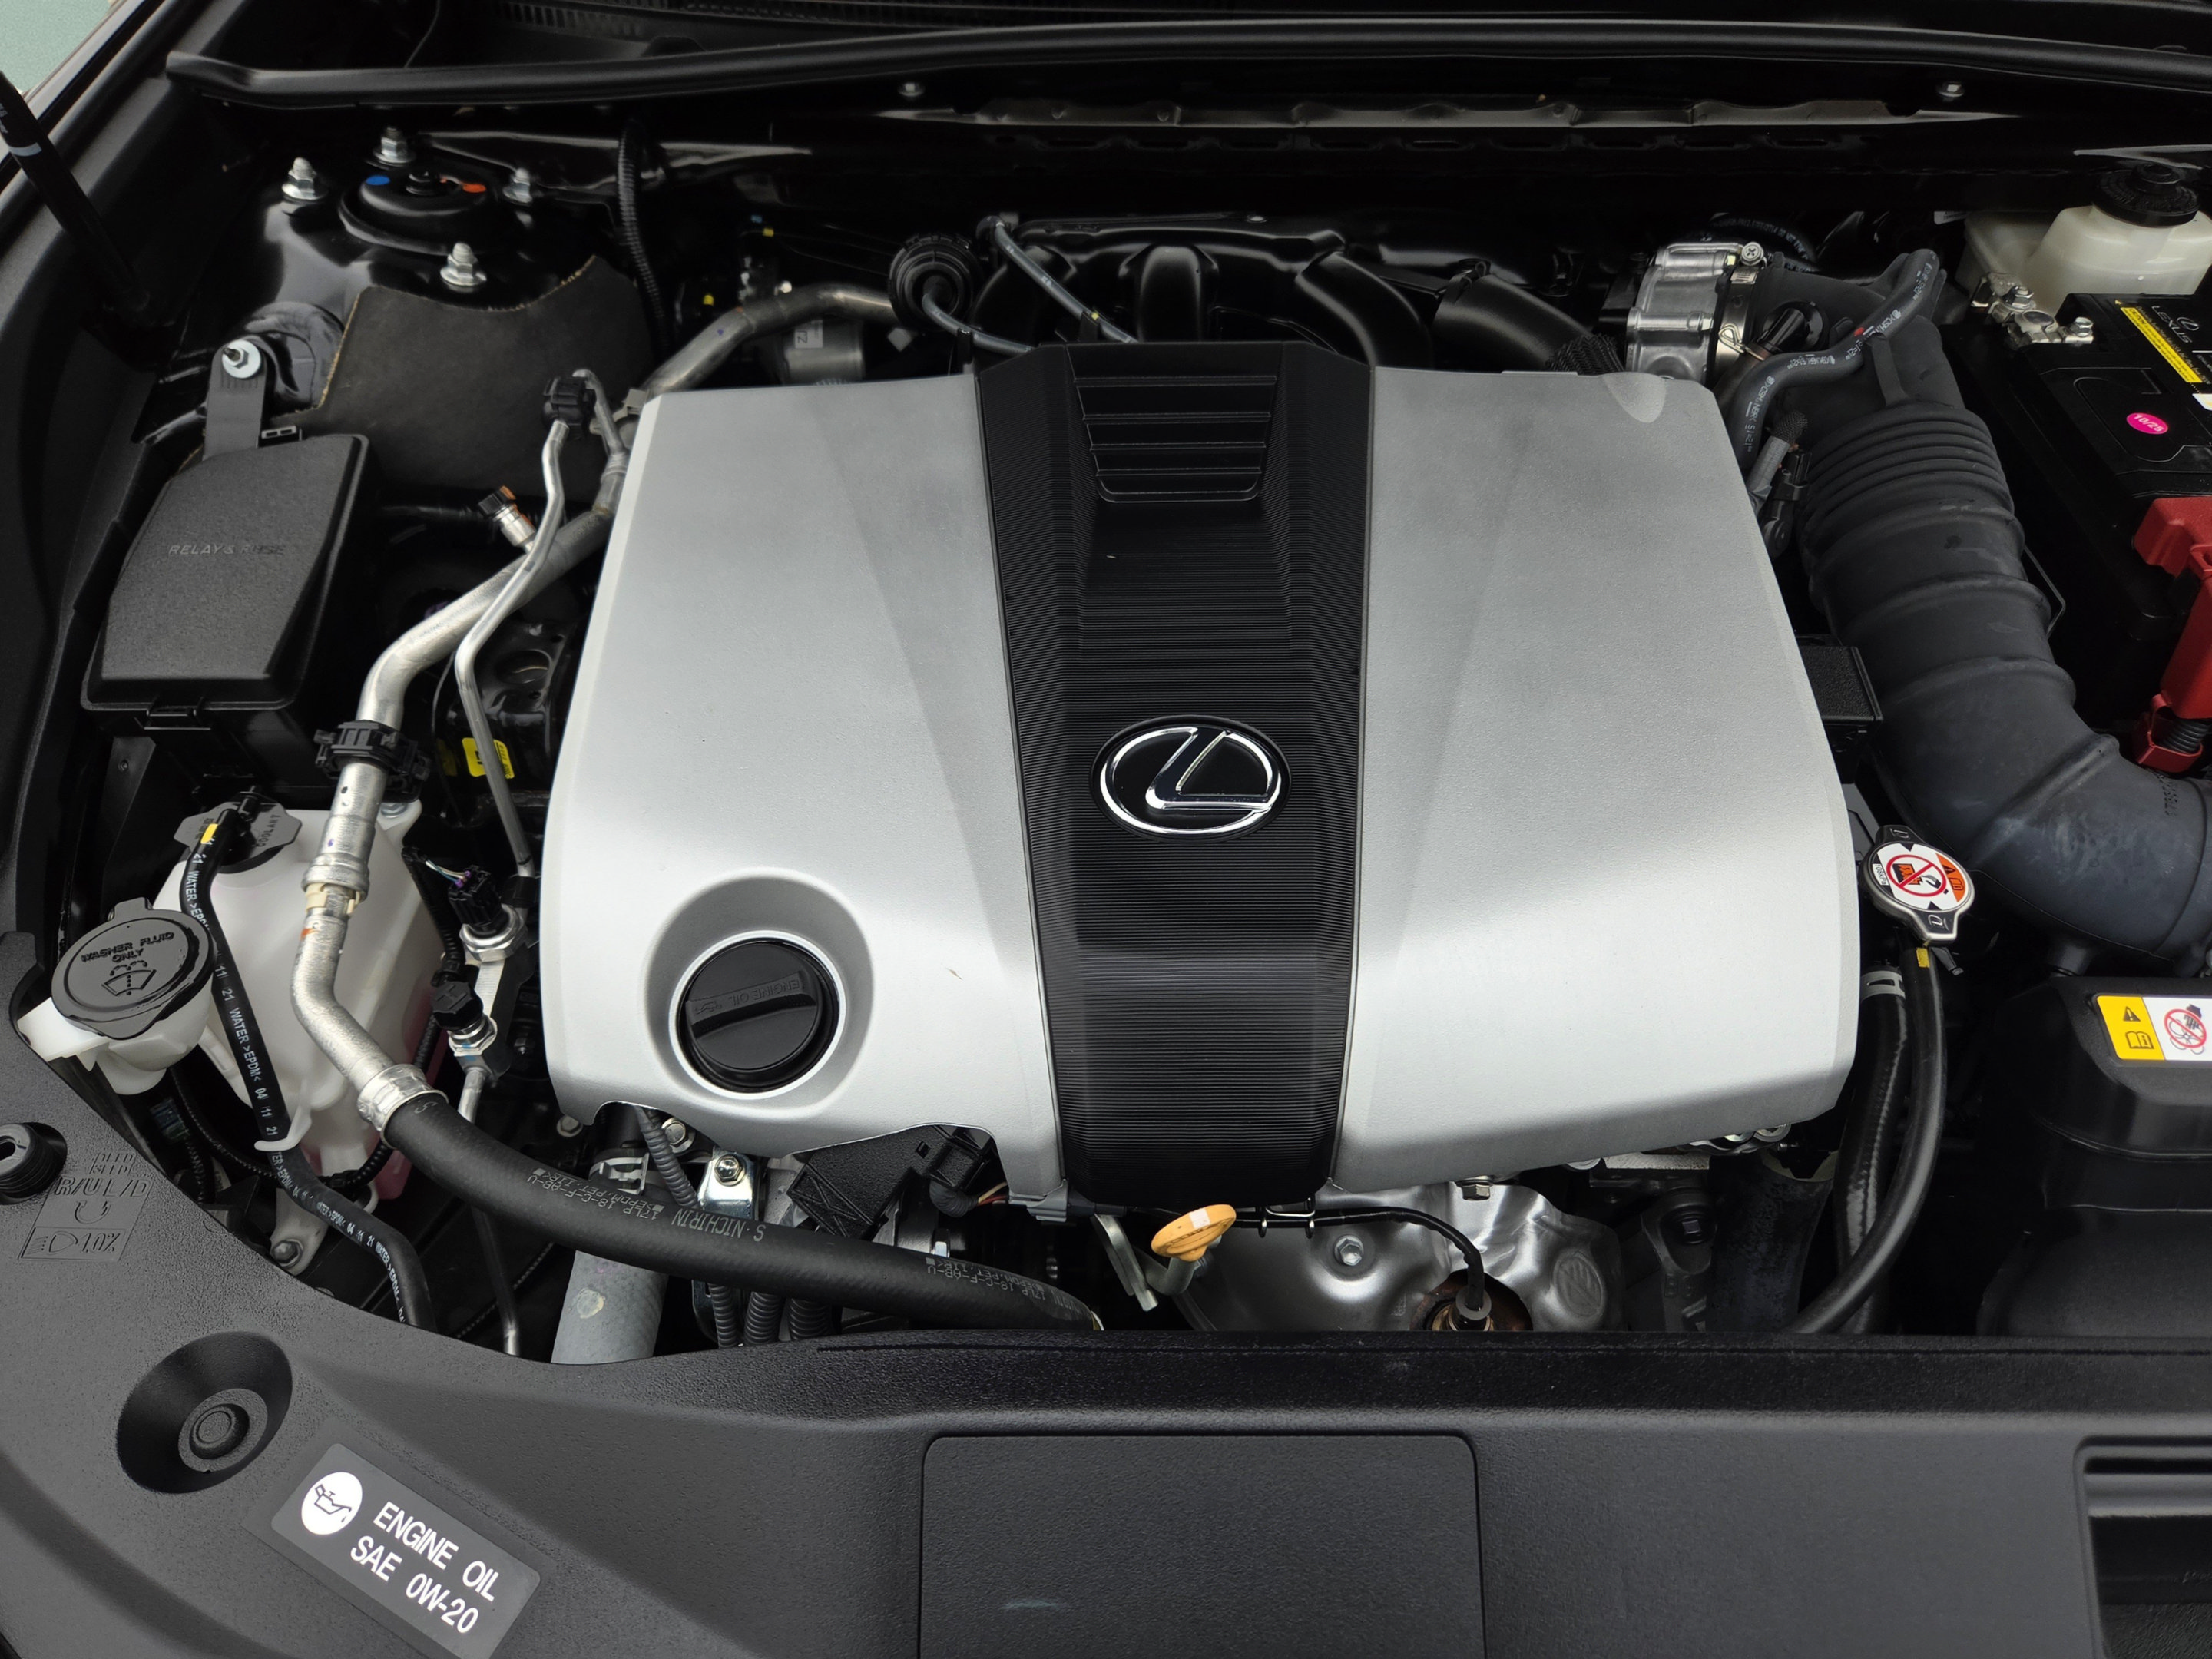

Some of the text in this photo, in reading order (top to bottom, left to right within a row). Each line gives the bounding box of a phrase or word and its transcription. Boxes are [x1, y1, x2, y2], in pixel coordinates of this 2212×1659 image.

[2151, 306, 2193, 343] LEXUS
[2134, 413, 2165, 432] 10/25
[185, 870, 200, 902] WATER
[81, 932, 175, 963] WASHER FLUID
[111, 948, 144, 963] ONLY
[728, 979, 800, 1006] ENGINE OIL
[221, 988, 235, 1002] 21
[230, 1007, 250, 1044] WATER
[254, 1088, 268, 1100] 04
[266, 1126, 278, 1136] 21
[623, 1207, 657, 1220] 17LP
[373, 1500, 499, 1602] ENGINE OIL
[350, 1535, 479, 1634] SAE 0W-20
